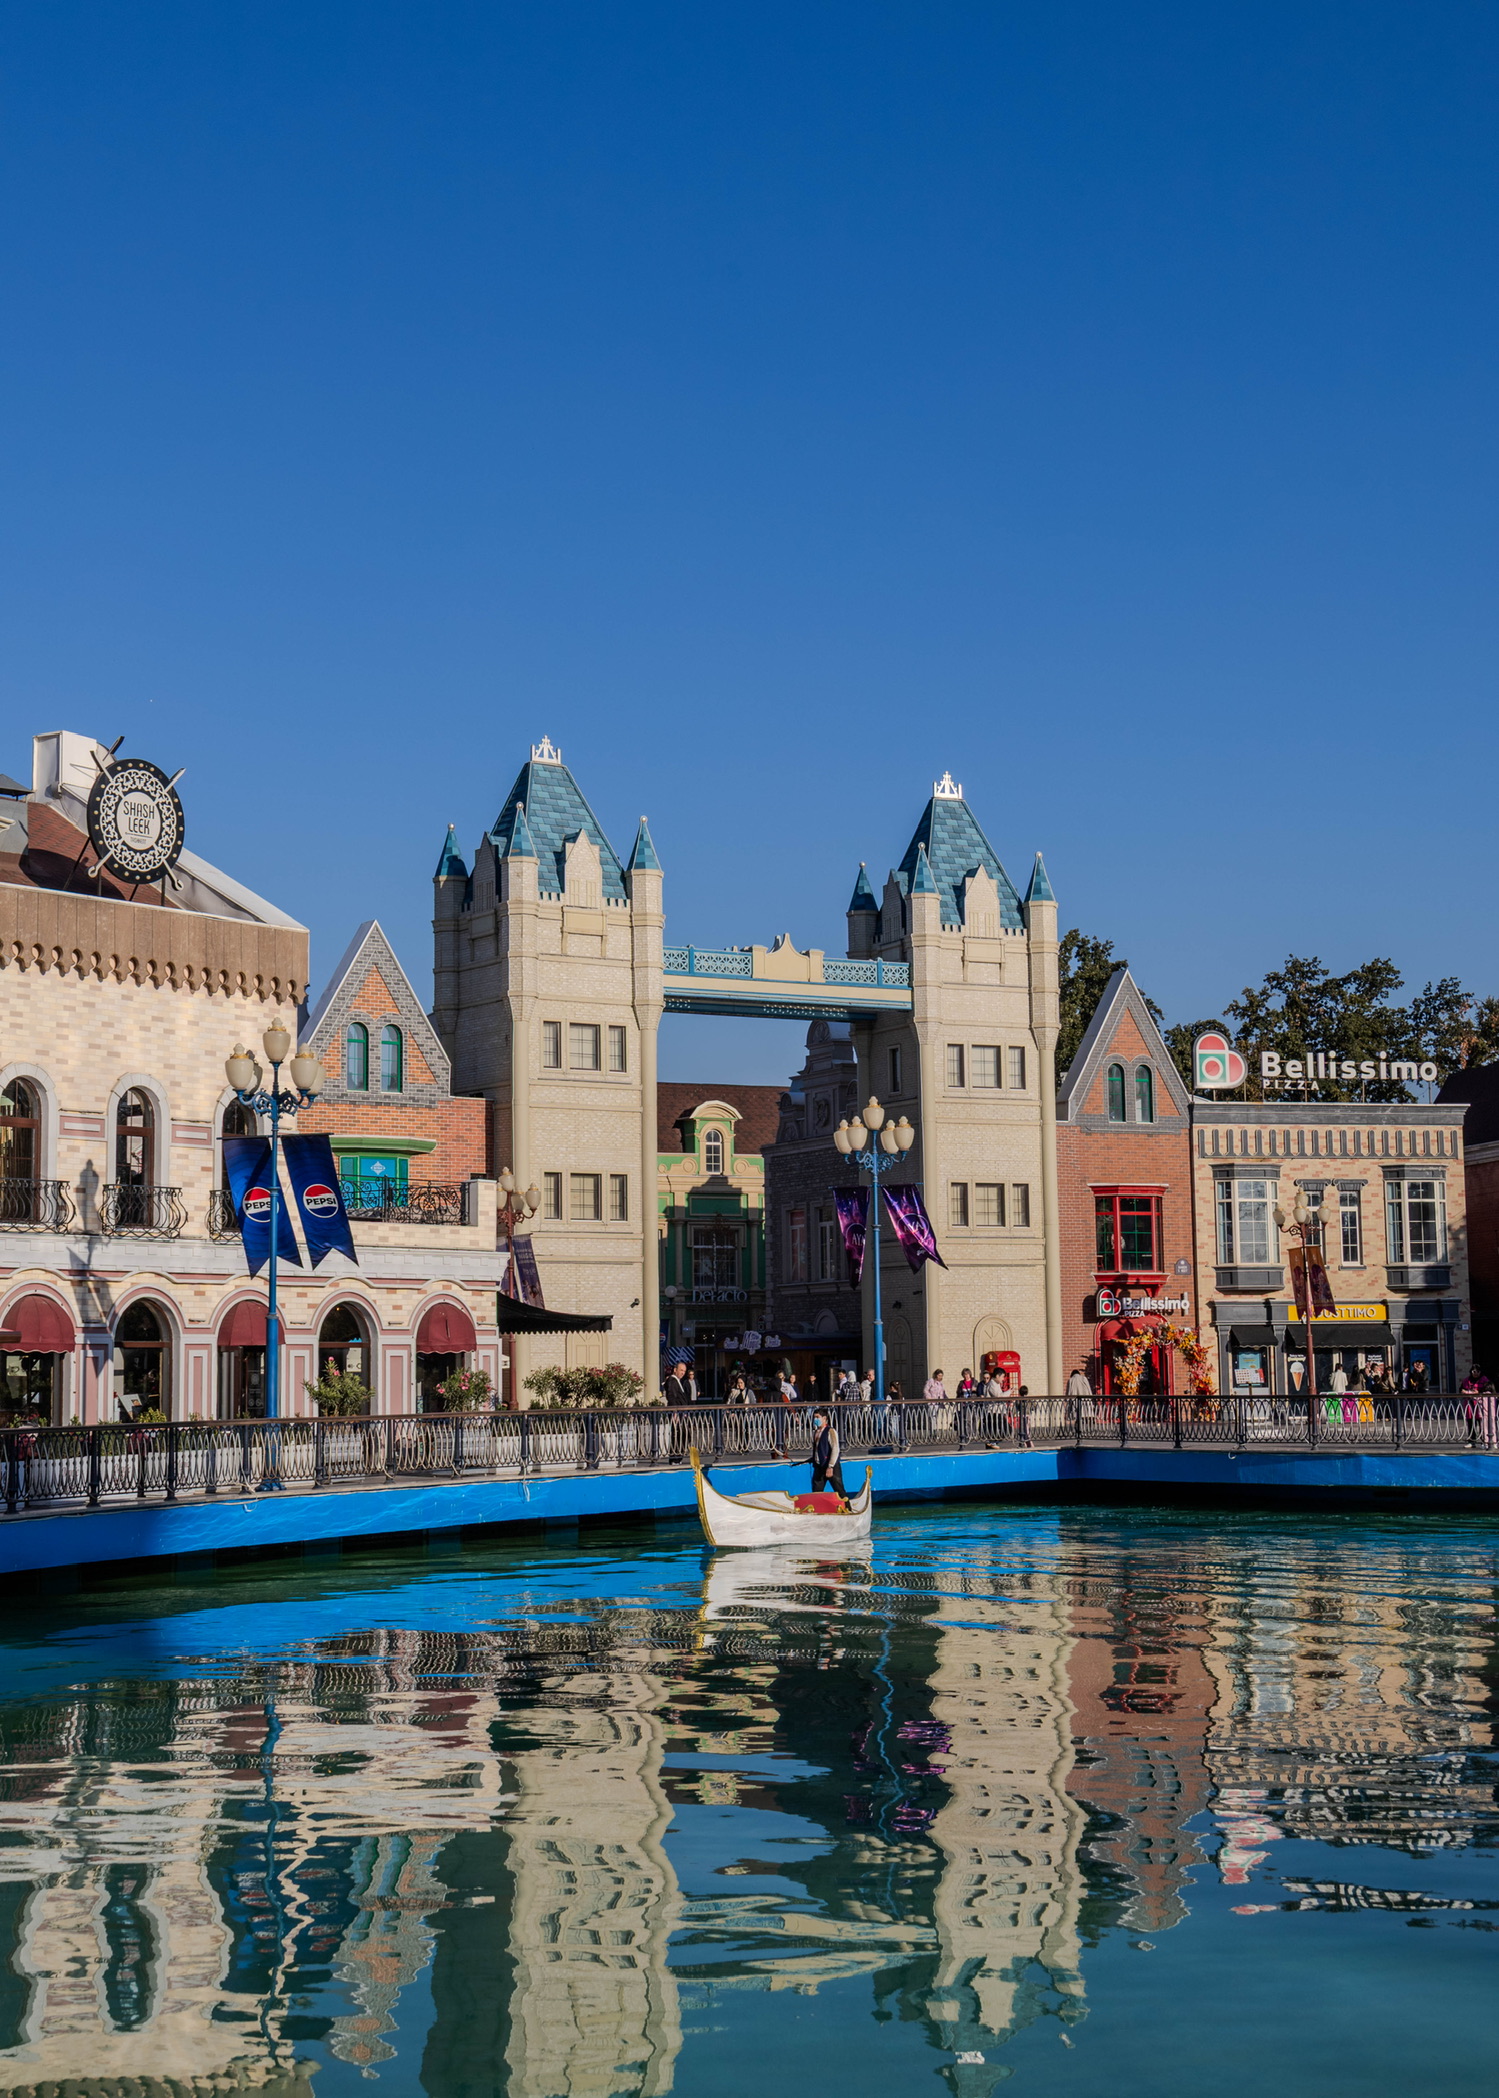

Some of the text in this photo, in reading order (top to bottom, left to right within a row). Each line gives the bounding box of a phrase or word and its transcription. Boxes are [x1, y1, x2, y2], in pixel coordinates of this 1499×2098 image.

[123, 800, 155, 819] SHASH
[128, 816, 150, 835] LEEK
[1261, 1050, 1438, 1082] Bellissimo
[1262, 1079, 1320, 1091] PIZZA
[306, 1197, 337, 1206] PEPSI
[1122, 1296, 1190, 1311] Bellissimo
[1123, 1310, 1146, 1318] PIZZA
